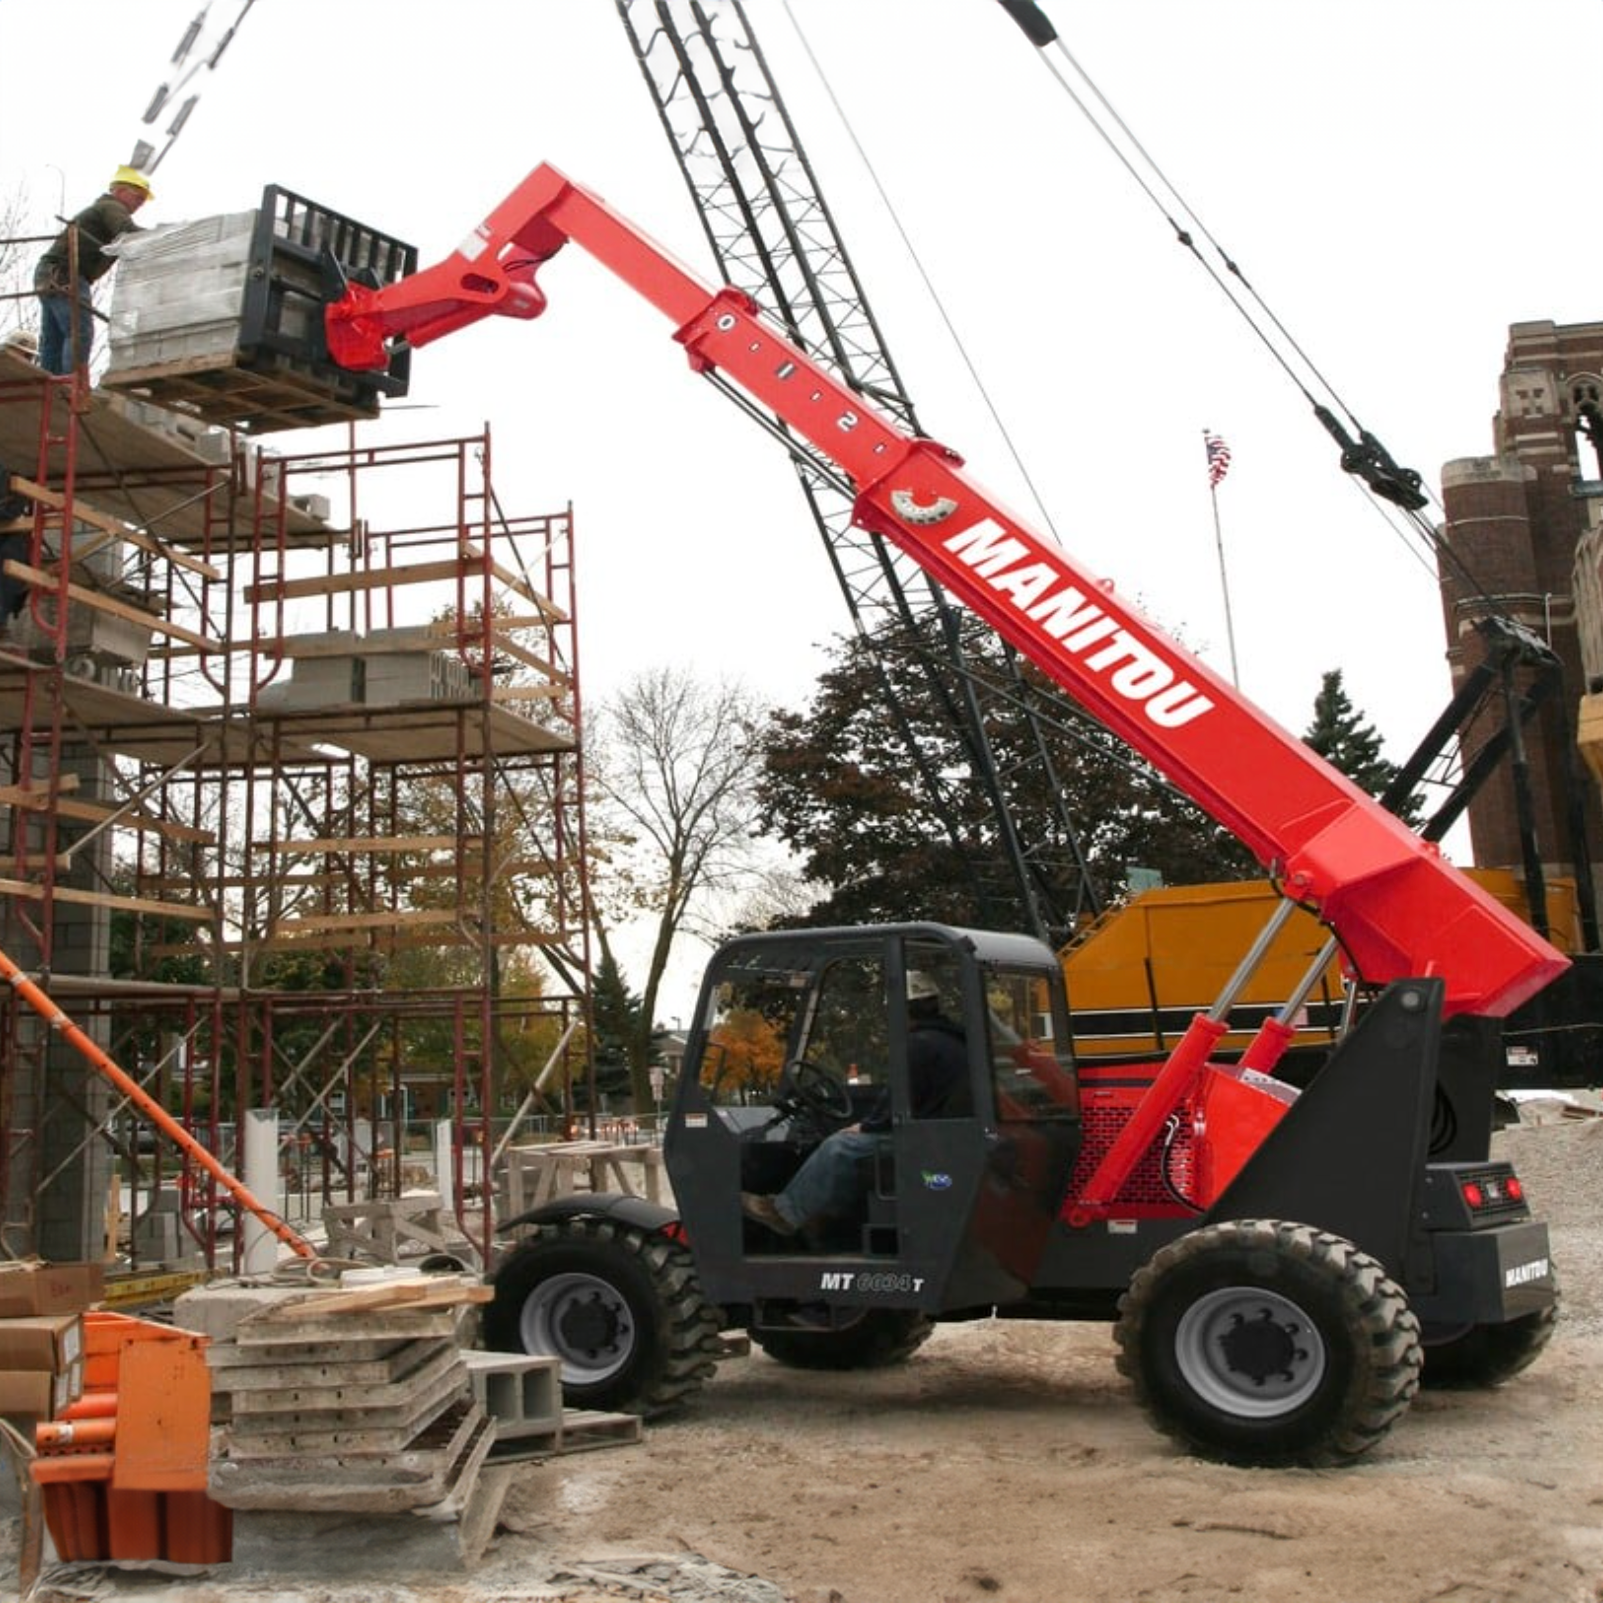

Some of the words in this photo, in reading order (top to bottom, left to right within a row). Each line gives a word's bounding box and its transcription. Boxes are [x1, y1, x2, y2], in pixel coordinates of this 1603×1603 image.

[836, 411, 858, 432] 2
[941, 517, 1216, 728] MANITOU
[821, 1272, 855, 1290] MT
[1505, 1258, 1548, 1288] MANITOU
